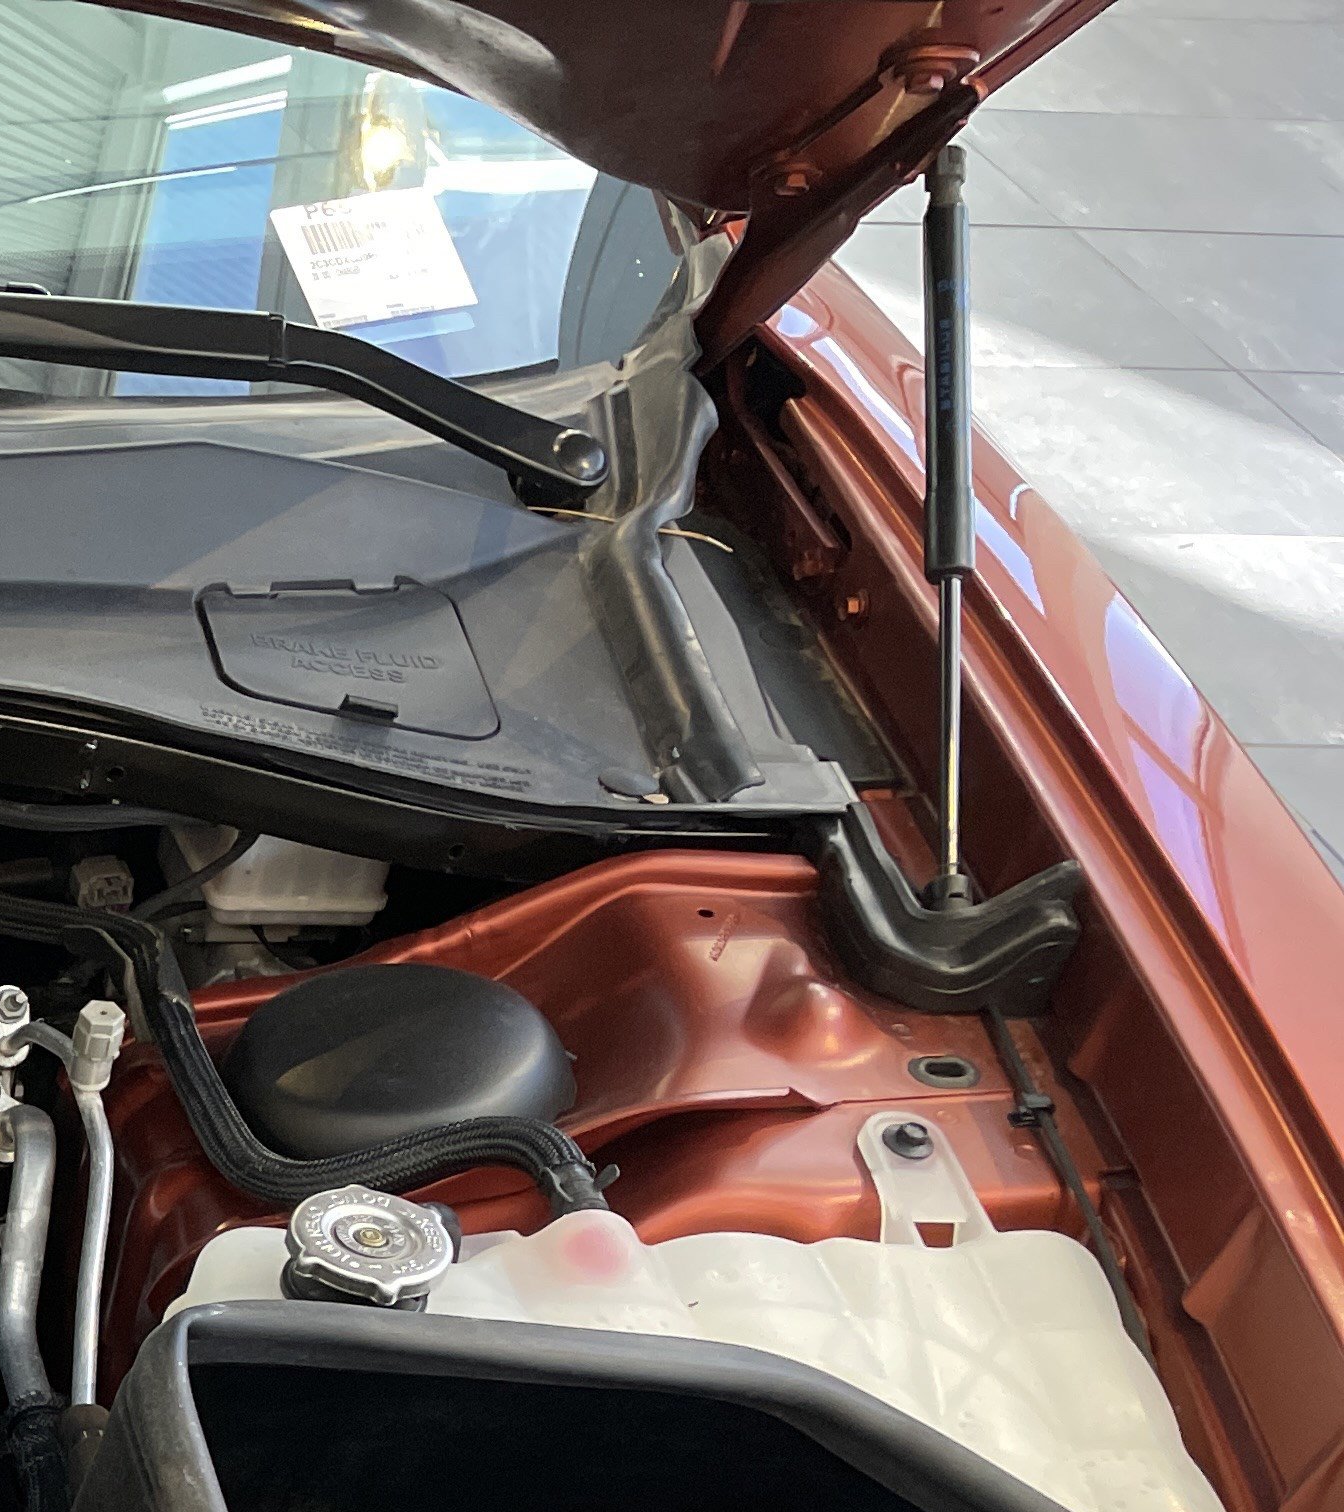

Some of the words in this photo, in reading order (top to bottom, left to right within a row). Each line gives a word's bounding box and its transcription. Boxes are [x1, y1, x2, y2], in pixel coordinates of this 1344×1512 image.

[250, 634, 351, 661] BRAKE
[356, 649, 441, 670] FLUID
[291, 656, 406, 684] ACCESS
